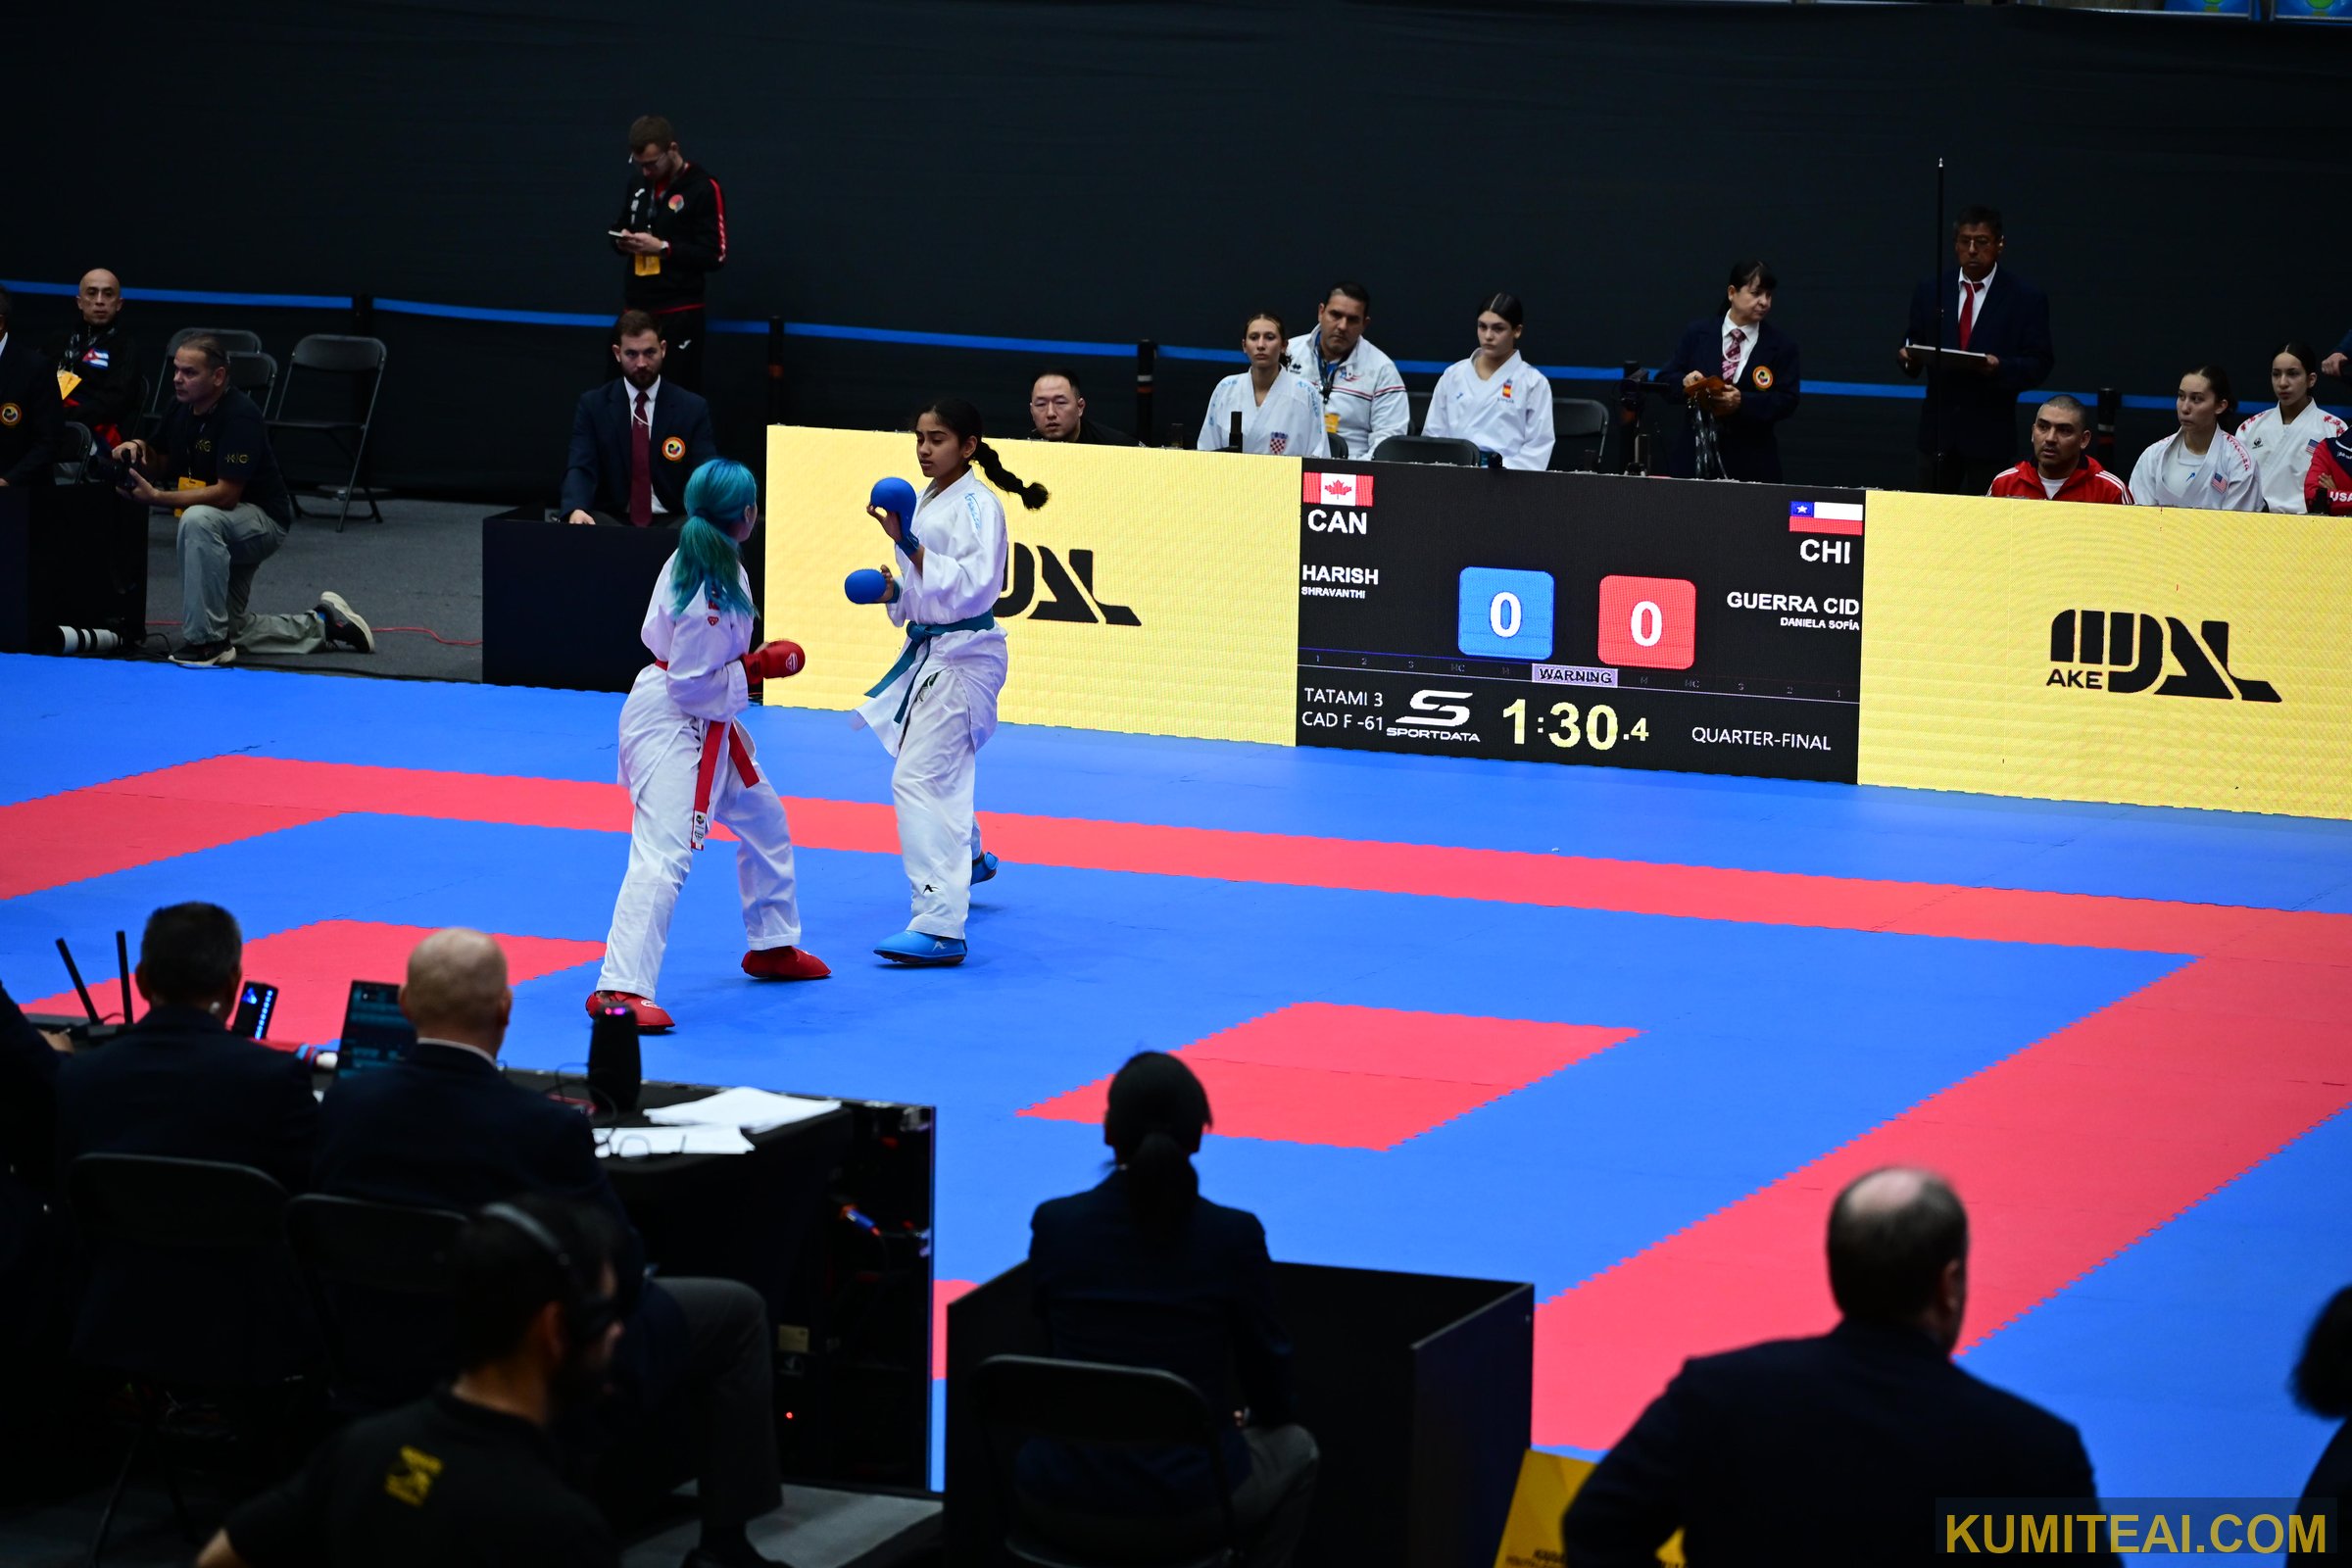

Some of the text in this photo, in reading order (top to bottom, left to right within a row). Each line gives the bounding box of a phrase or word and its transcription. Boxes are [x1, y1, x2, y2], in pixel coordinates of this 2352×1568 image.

[1307, 509, 1367, 535] CAN
[1799, 538, 1851, 564] CHI
[1301, 564, 1379, 585] HARISH
[1300, 586, 1366, 600] SHRAVANTHI
[1726, 591, 1860, 615] GUERRA CID
[1490, 591, 1522, 638] 0
[1630, 601, 1663, 647] 0
[1780, 616, 1860, 631] DANIELA SOFÍA
[1539, 667, 1613, 684] WARNING
[2045, 668, 2103, 690] AKE
[1304, 687, 1384, 708] TATAMI 3
[1301, 711, 1383, 731] CAD F -61
[1386, 727, 1481, 743] SPORTDATA
[1691, 726, 1832, 751] QUARTER-FINAL
